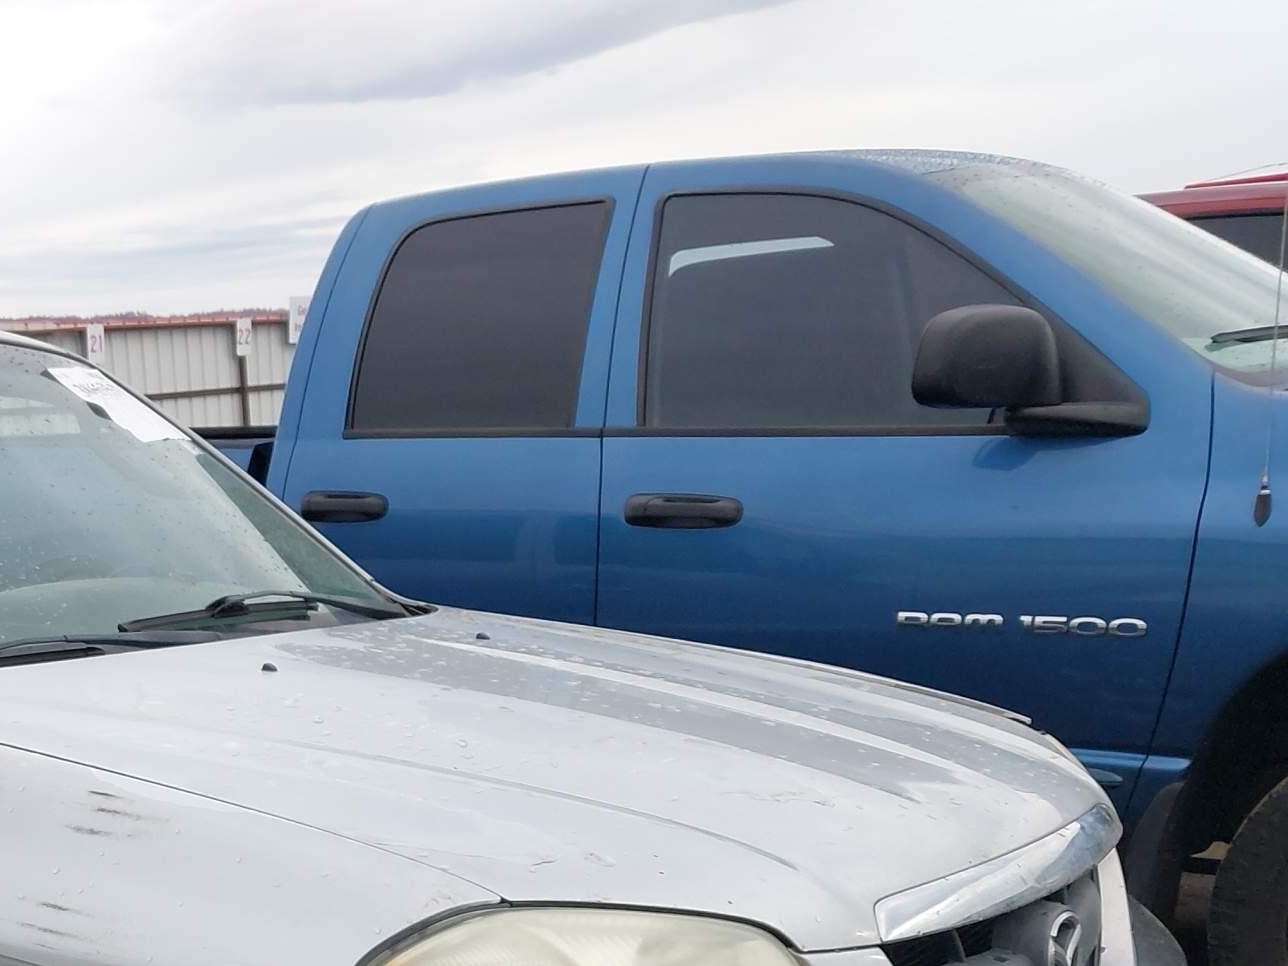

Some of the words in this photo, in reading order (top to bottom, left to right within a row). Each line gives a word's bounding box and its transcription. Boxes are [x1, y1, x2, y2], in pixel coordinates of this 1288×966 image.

[90, 335, 103, 353] 21
[238, 327, 252, 345] 22
[1019, 615, 1148, 637] 1500
